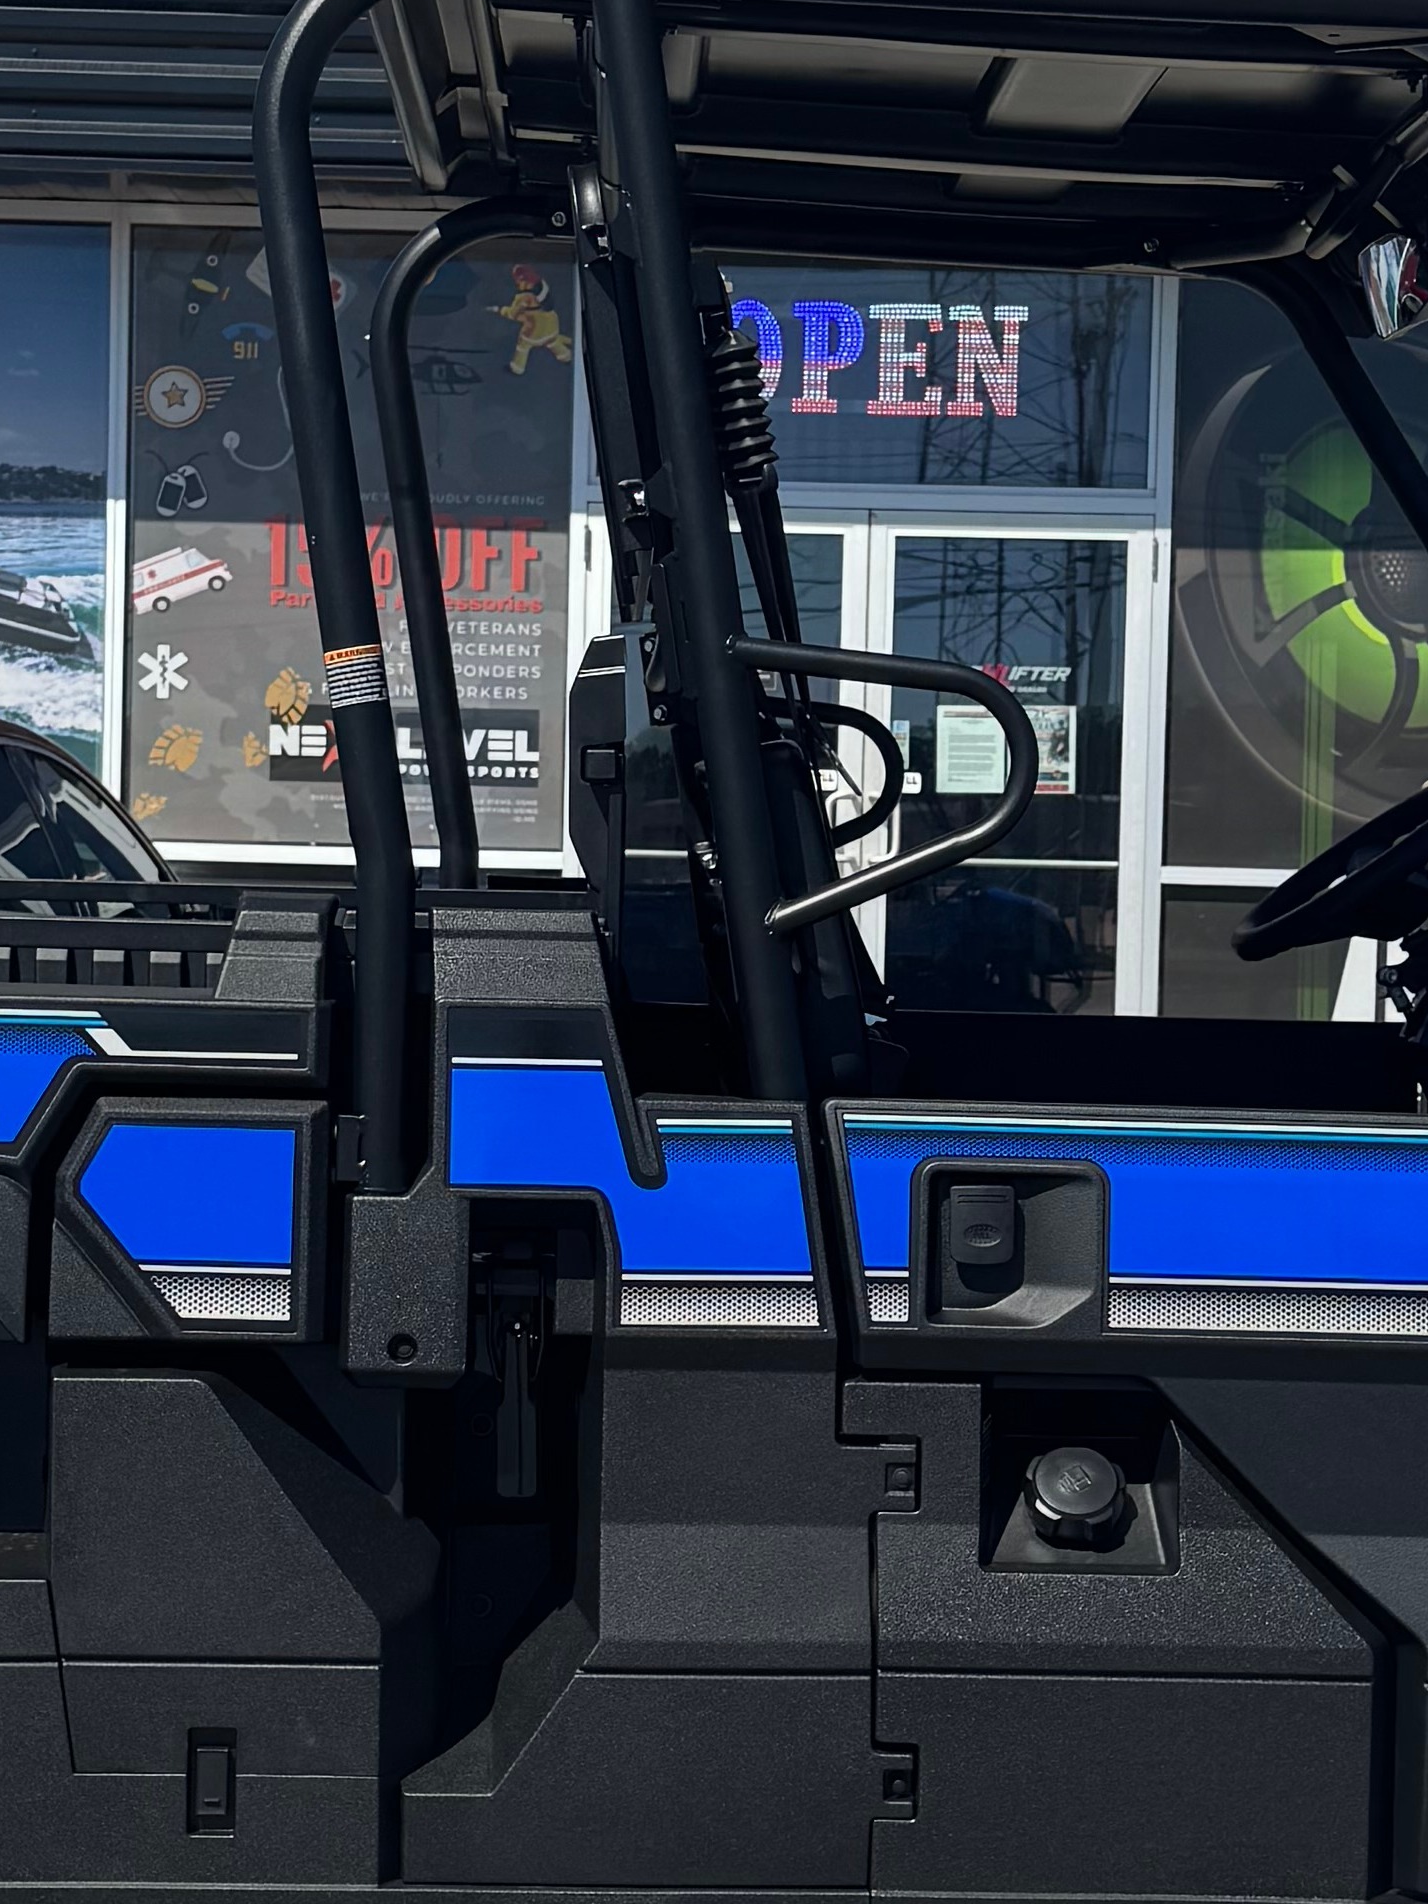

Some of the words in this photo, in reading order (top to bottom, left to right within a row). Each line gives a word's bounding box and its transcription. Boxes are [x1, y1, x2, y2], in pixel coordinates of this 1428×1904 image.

[234, 342, 257, 360] 911
[730, 299, 1029, 417] OPEN
[430, 493, 471, 505] UDLY
[475, 494, 545, 506] OFFERING
[432, 516, 545, 593] OFF
[270, 589, 313, 609] Par
[394, 593, 544, 614] essories
[400, 641, 543, 658] ERCEMENT
[454, 665, 542, 679] PONDERS
[457, 686, 529, 700] ORKERS
[269, 720, 338, 773] NE
[397, 727, 540, 762] LVEL
[398, 764, 540, 779] POSPORTS
